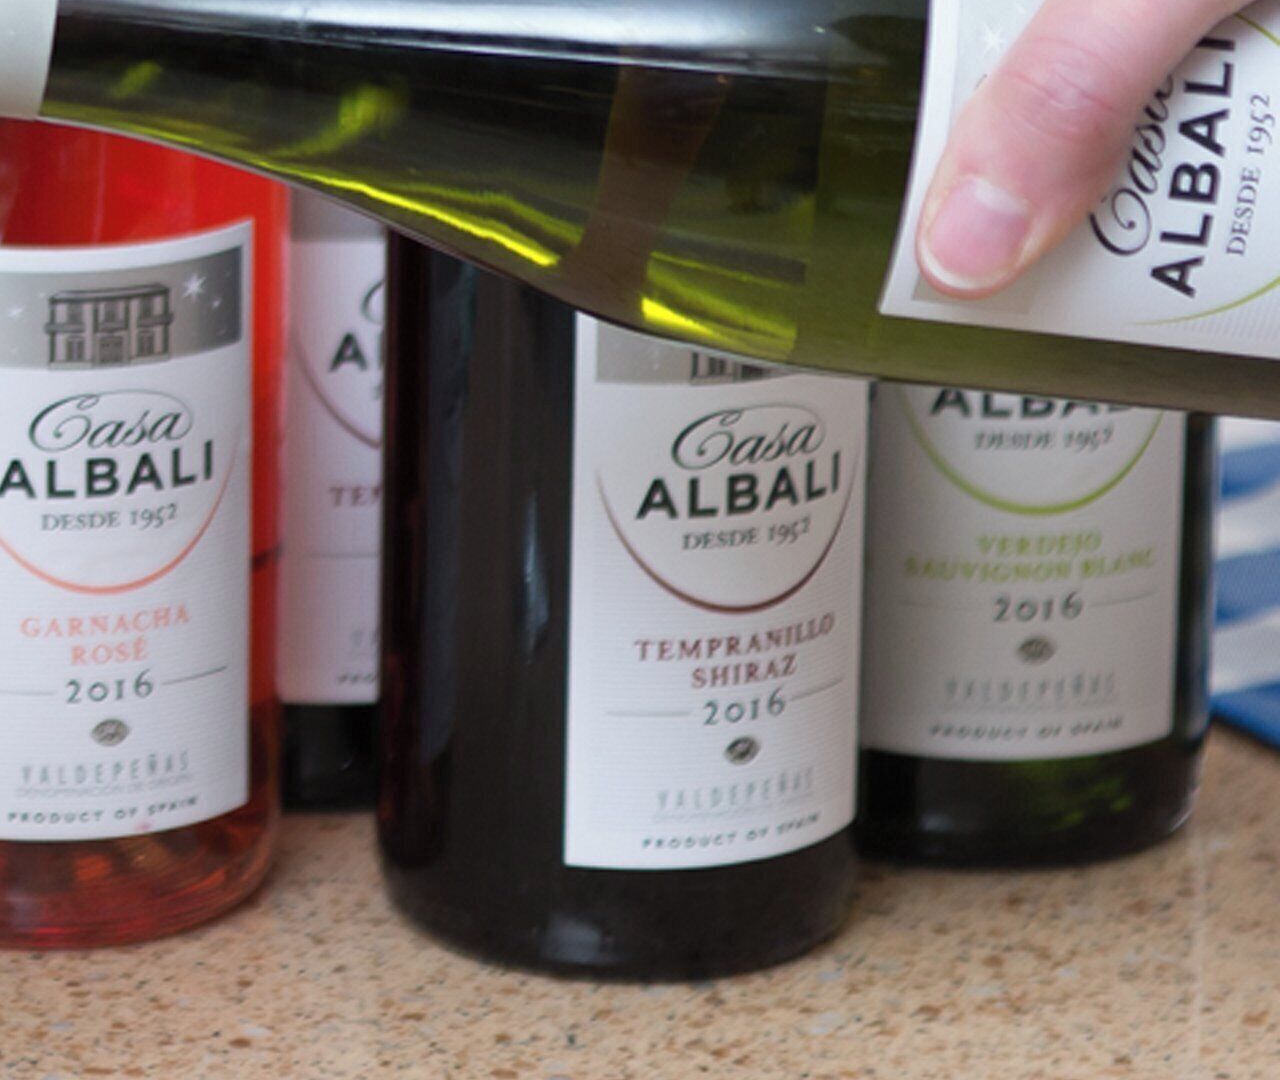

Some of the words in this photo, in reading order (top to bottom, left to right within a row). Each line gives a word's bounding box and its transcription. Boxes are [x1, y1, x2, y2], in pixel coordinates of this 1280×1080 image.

[1150, 35, 1237, 299] ALBALI
[1225, 167, 1261, 257] DESDE
[1246, 93, 1277, 156] 1952
[27, 387, 195, 453] Casa
[928, 386, 1130, 420] ALB
[670, 402, 827, 471] Casa
[635, 450, 841, 521] ALBALI
[40, 510, 122, 533] DESDE
[129, 502, 179, 532] 1952
[681, 526, 761, 551] DESDE
[767, 516, 812, 545] 1952
[19, 602, 192, 639] GARNACHA
[992, 590, 1084, 623] 2016
[70, 634, 150, 667] ROSÉ
[634, 611, 836, 663] TEMPRANILLO
[64, 668, 155, 705] 2016
[691, 653, 798, 689] SHIRAZ
[702, 685, 787, 726] 2016
[7, 810, 105, 825] PRODUCT
[113, 805, 138, 820] OF
